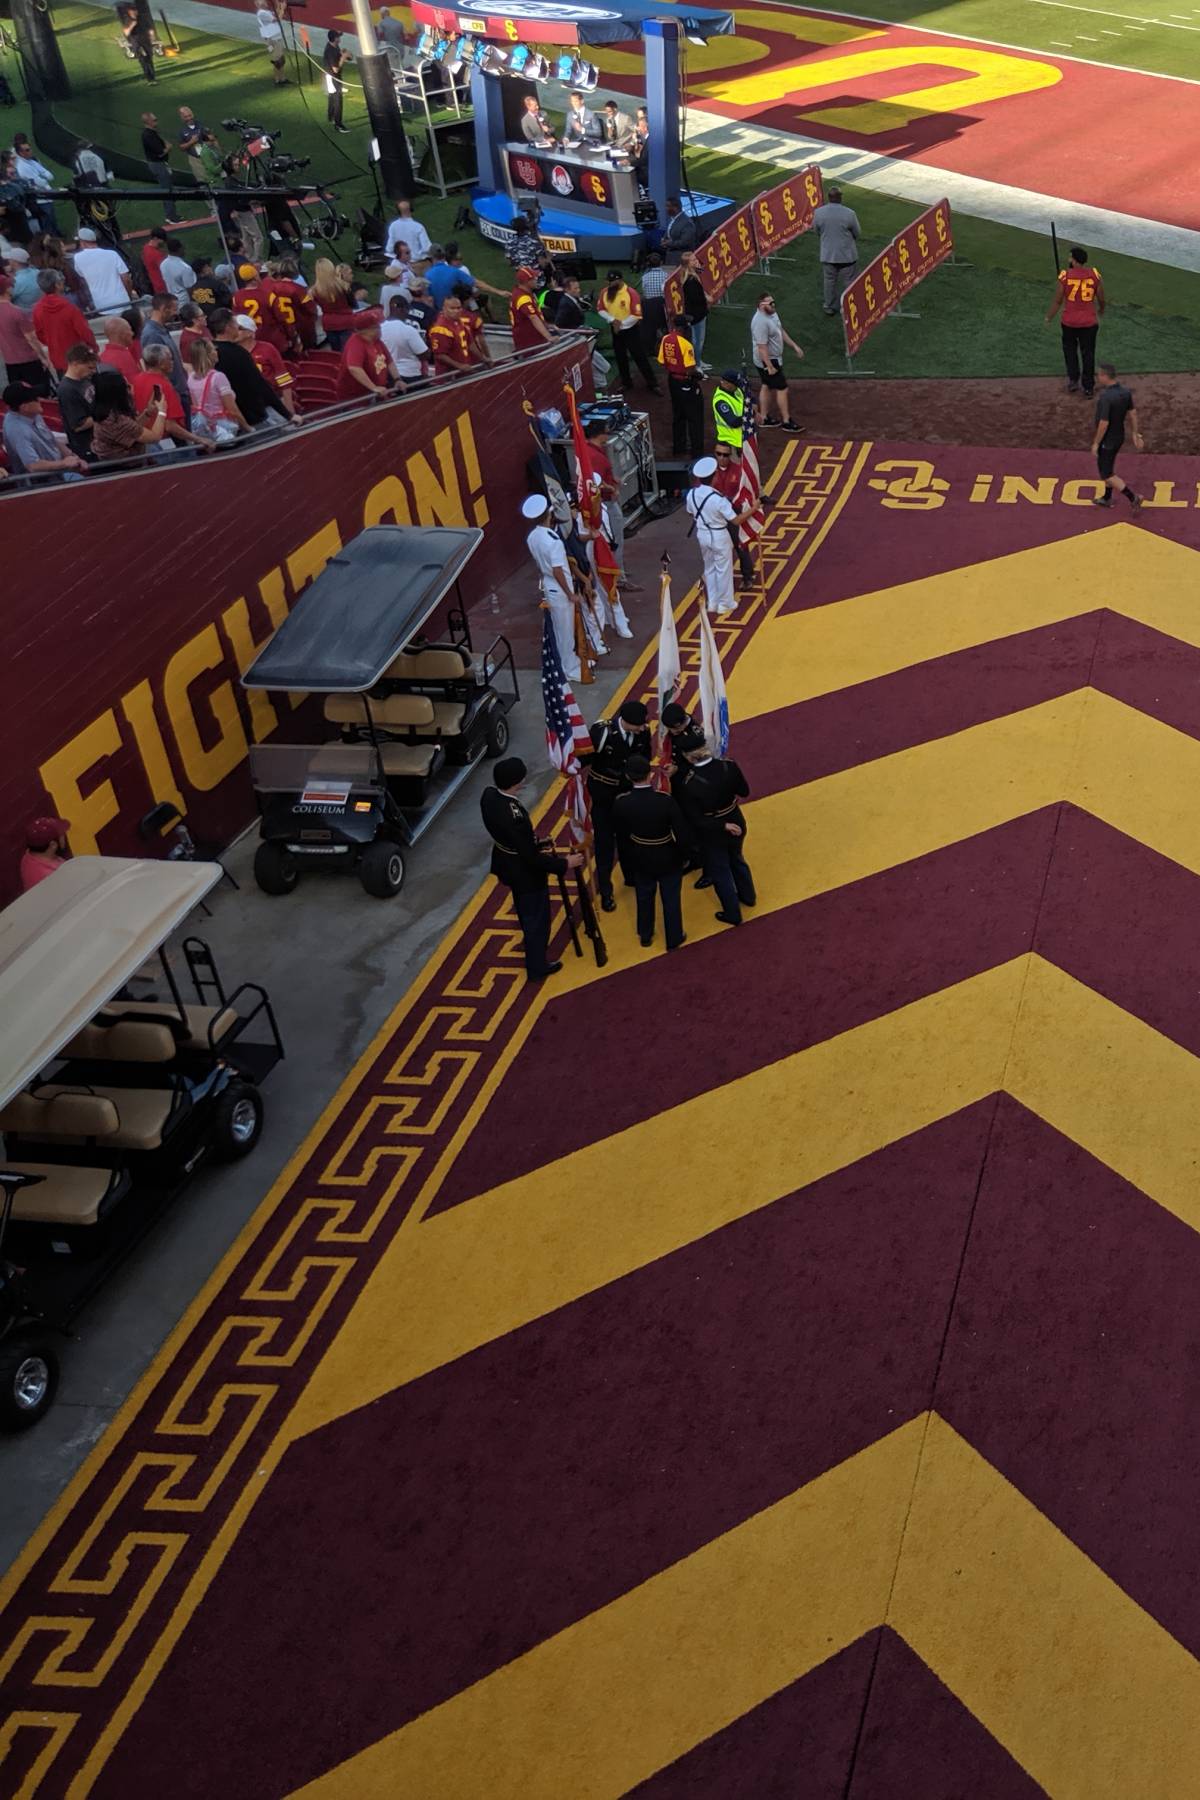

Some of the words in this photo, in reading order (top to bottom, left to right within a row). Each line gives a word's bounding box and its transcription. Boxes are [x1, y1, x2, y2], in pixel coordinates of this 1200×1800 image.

[591, 175, 606, 202] SC
[782, 187, 797, 221] SC
[804, 174, 818, 208] SC
[737, 217, 751, 251] SC
[759, 201, 774, 235] SC
[935, 208, 947, 242] SC
[543, 239, 572, 252] TBALL
[719, 232, 732, 267] SC
[898, 239, 911, 274] SC
[917, 223, 929, 258] SC
[707, 246, 720, 281] SC
[881, 256, 893, 292] SC
[864, 274, 876, 311] SC
[1067, 278, 1095, 302] 76
[279, 297, 296, 324] 5
[868, 459, 950, 510] SC
[292, 804, 346, 815] COLISEUM
